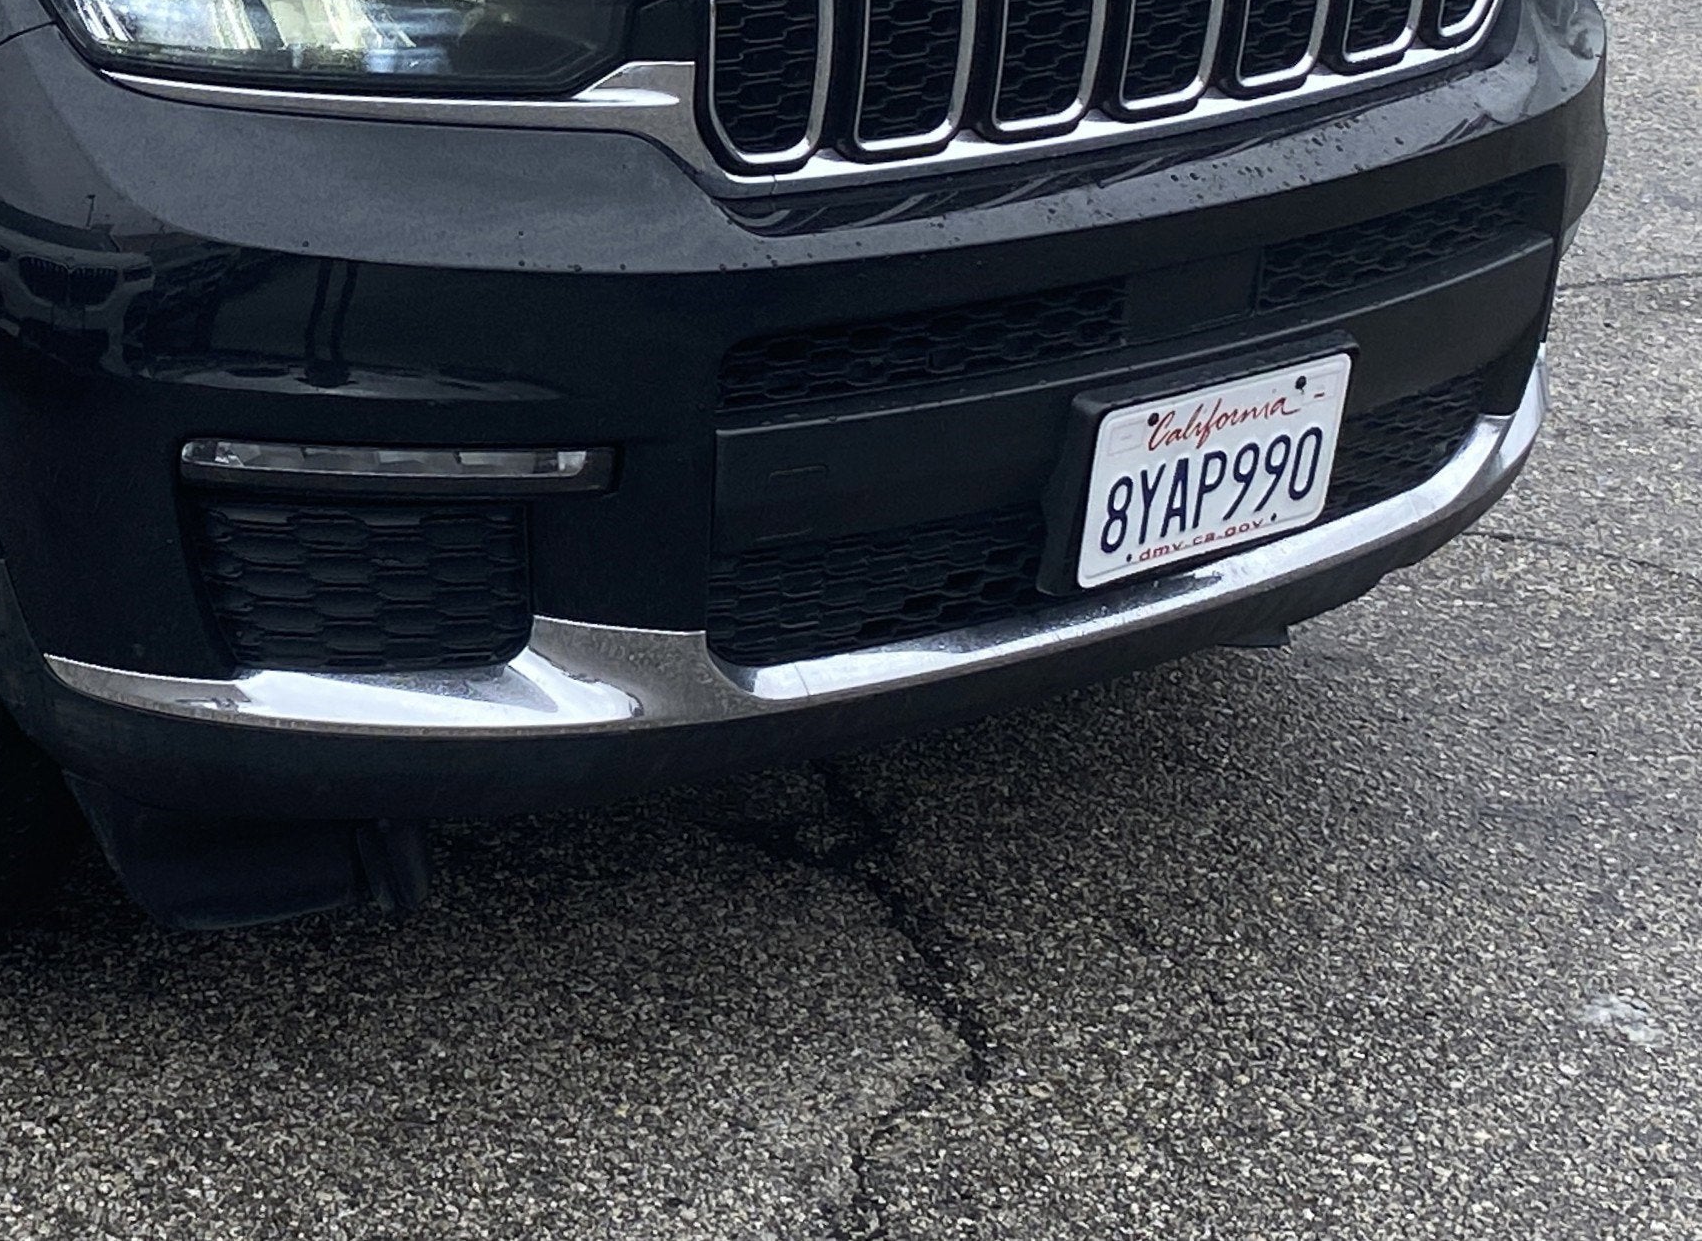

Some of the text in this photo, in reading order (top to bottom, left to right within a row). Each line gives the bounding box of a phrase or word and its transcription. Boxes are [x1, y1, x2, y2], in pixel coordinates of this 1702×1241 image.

[1148, 398, 1301, 450] California
[1101, 427, 1323, 554] 8YAP990
[1137, 518, 1264, 562] dmv.ca.gov
